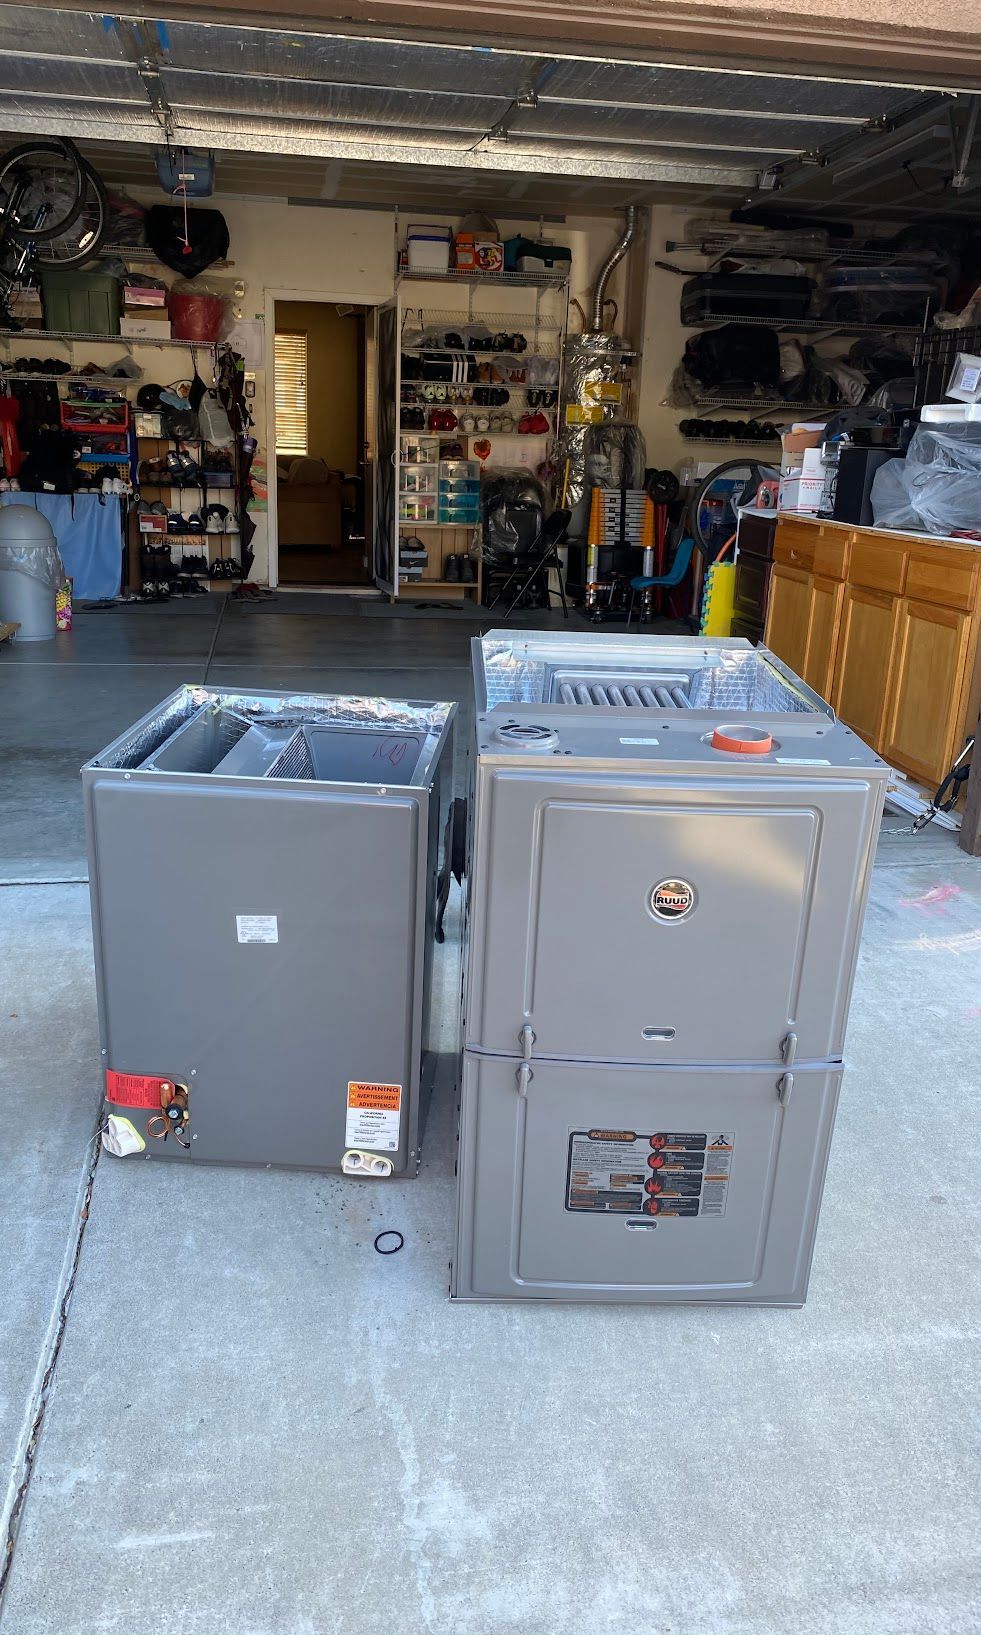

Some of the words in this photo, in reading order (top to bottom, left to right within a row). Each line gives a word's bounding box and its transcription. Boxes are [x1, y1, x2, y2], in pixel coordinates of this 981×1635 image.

[656, 896, 688, 905] RUUD
[357, 1085, 399, 1093] WARNING
[357, 1093, 399, 1101] AVERTISSEMENT
[358, 1101, 397, 1109] ADVERTENCIA
